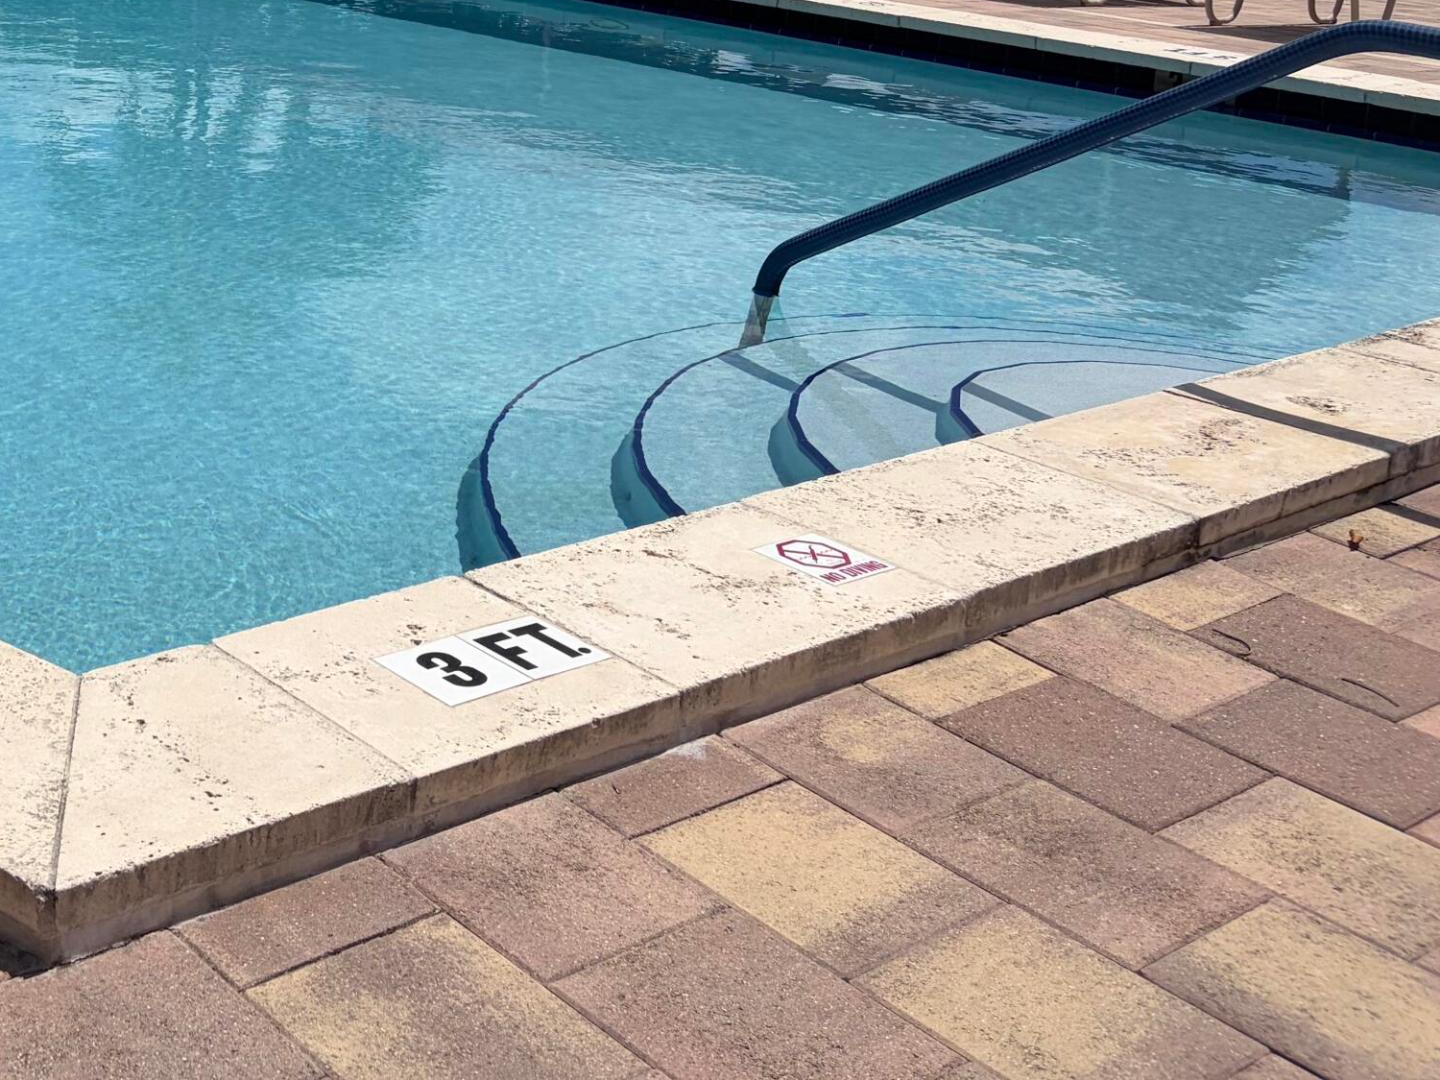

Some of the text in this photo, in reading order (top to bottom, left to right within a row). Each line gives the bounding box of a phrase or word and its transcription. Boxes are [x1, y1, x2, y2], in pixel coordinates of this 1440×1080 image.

[819, 560, 888, 583] NO DIVING
[416, 622, 592, 687] 3 FT.
